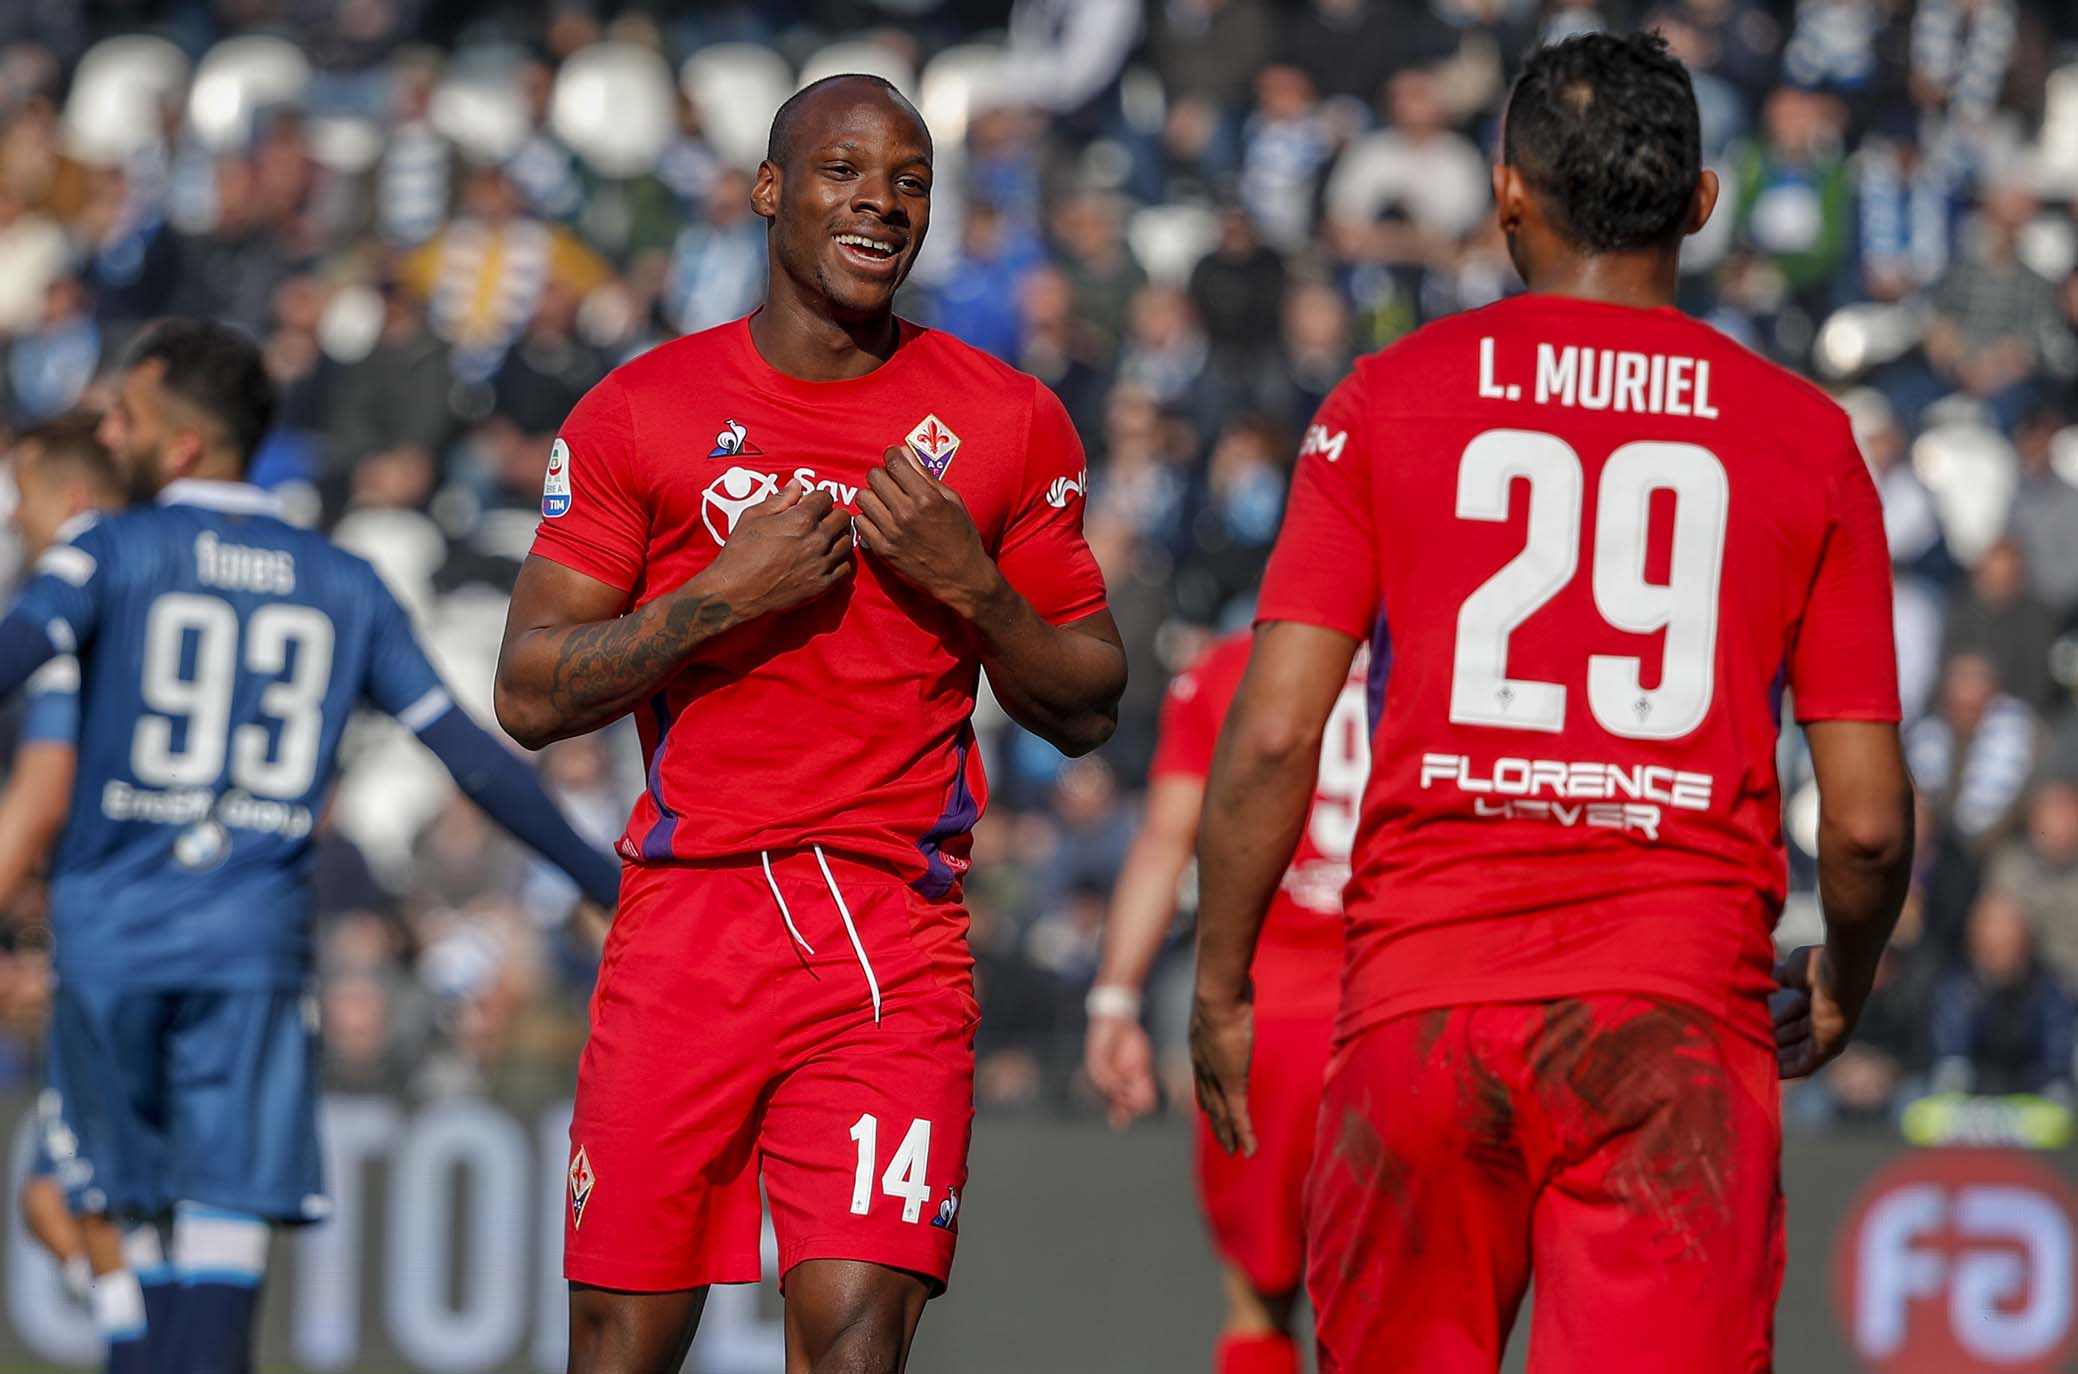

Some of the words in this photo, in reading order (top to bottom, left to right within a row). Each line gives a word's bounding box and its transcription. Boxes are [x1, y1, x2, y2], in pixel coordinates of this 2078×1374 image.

[1479, 337, 1521, 401] L.
[1535, 343, 1719, 419] MURIEL
[549, 499, 565, 511] TIM
[794, 468, 858, 506] Sav
[1449, 428, 1730, 740] 29
[131, 591, 335, 799] 93
[1420, 753, 1713, 811] FLORENCE
[849, 1113, 931, 1224] 14
